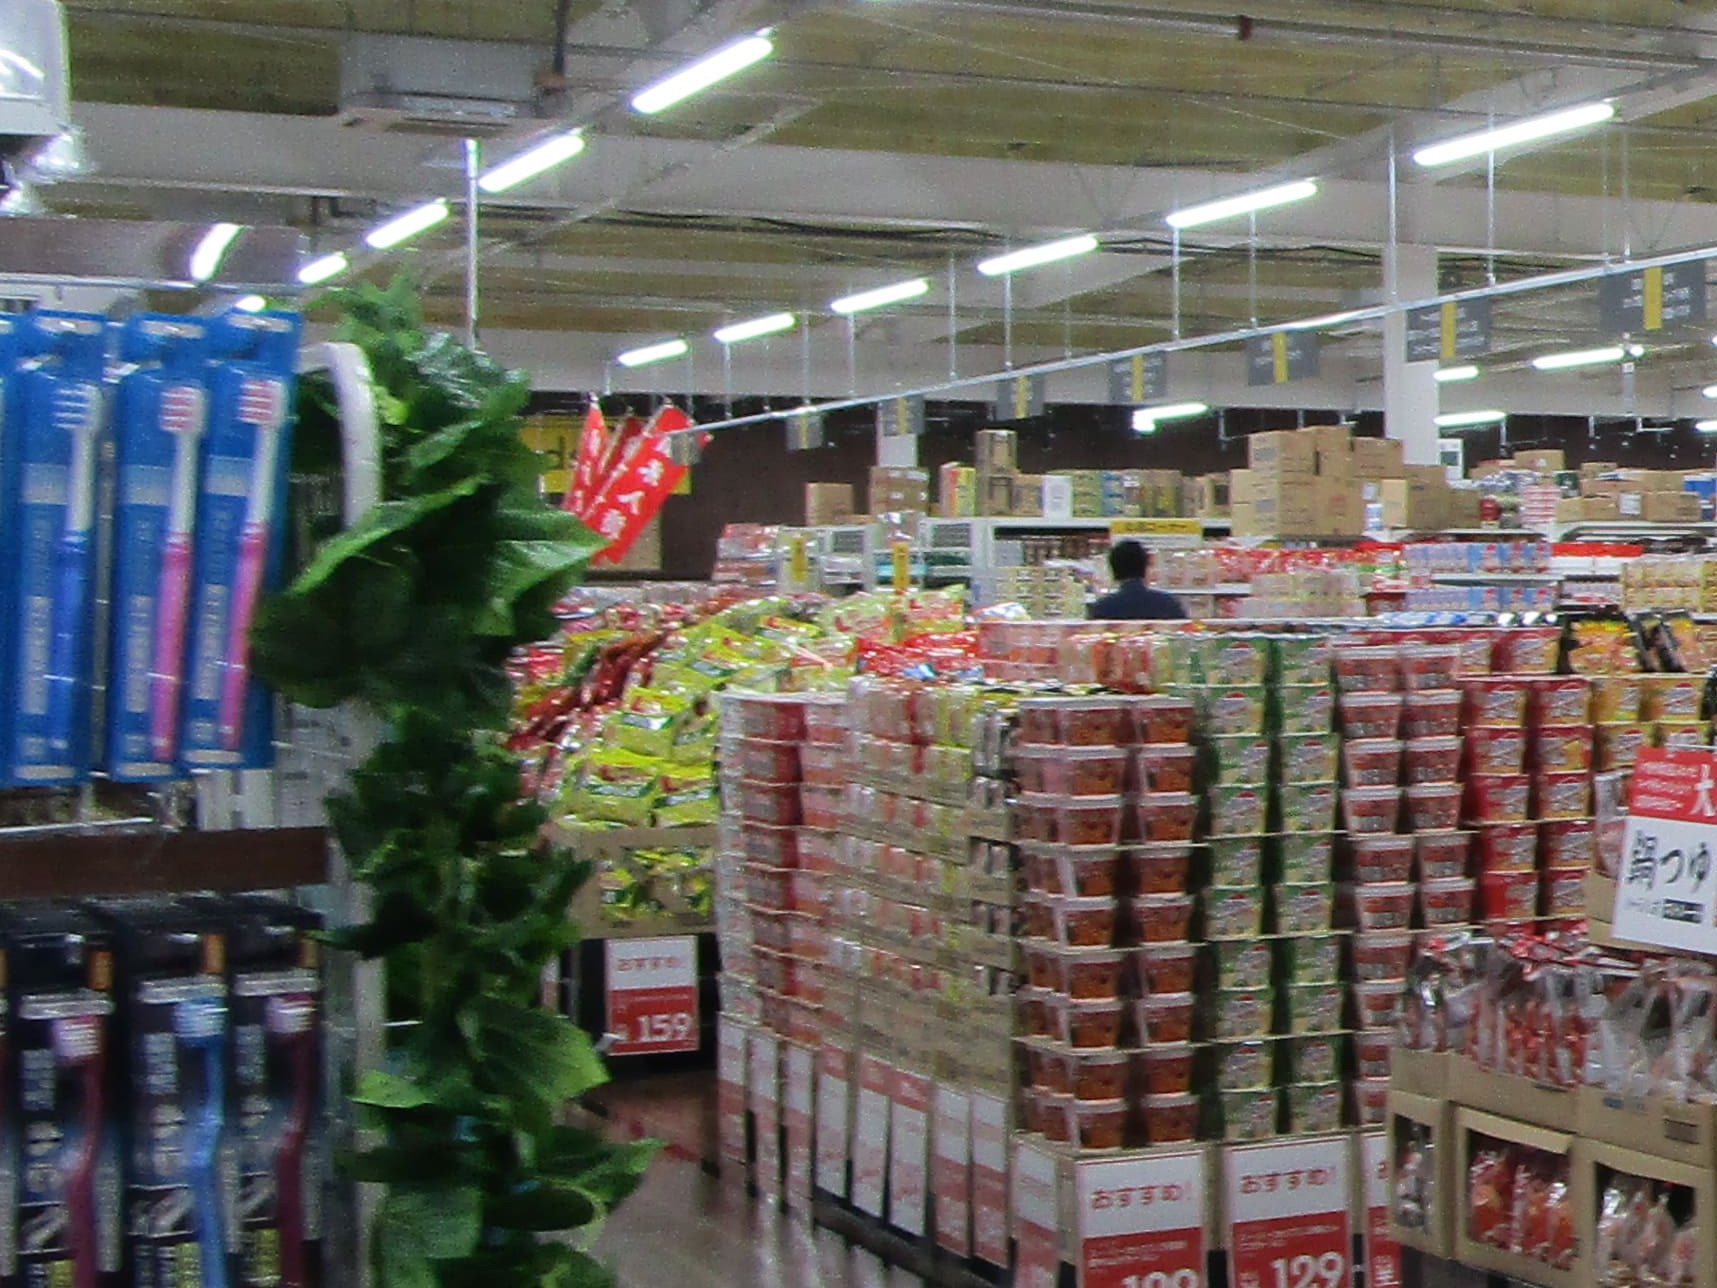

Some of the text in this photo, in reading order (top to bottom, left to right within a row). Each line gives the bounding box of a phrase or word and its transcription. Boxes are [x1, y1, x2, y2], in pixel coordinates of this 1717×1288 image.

[1627, 828, 1710, 894] 鍋つゆ
[636, 1012, 690, 1042] 159
